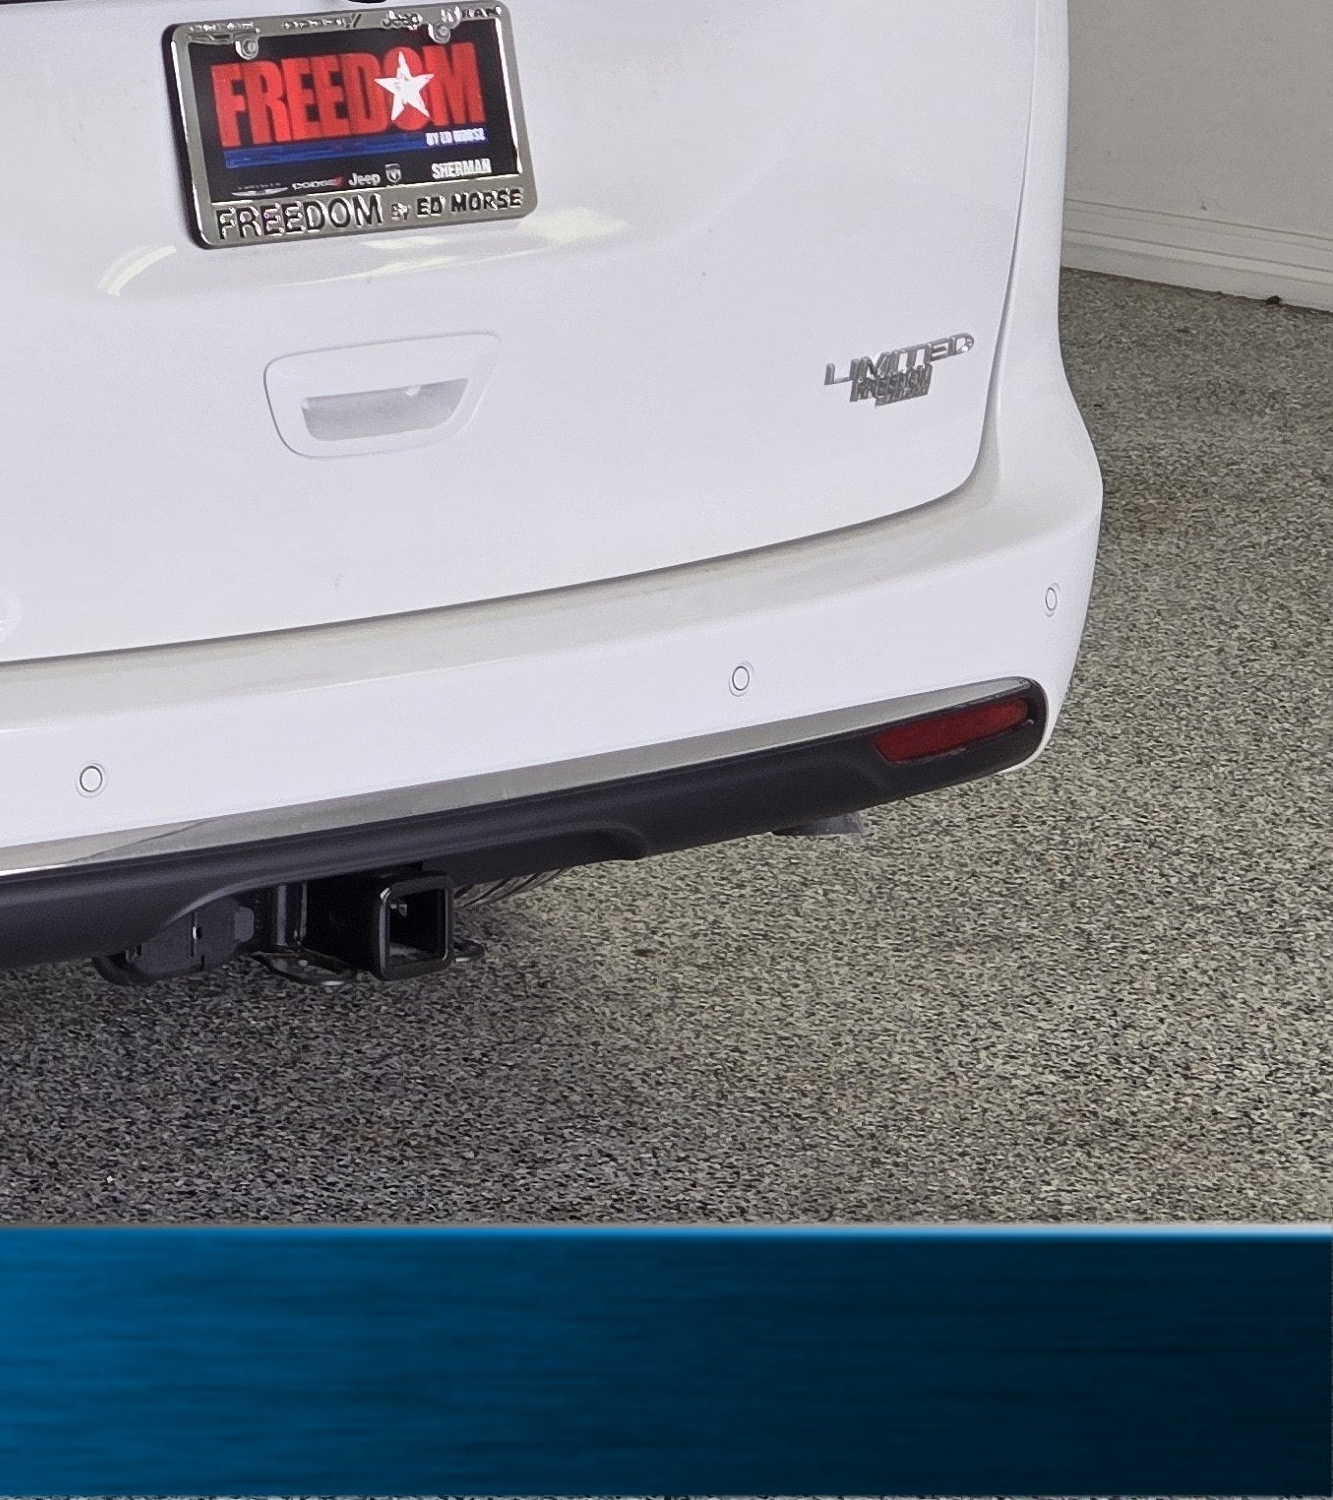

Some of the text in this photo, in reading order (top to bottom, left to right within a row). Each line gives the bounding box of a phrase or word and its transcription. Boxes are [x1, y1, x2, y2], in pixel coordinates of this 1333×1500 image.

[210, 41, 487, 148] FREEDOM
[348, 172, 381, 187] Jeep
[431, 158, 492, 179] SHERMAN
[215, 193, 384, 240] FREEDOM
[416, 196, 446, 218] ED
[450, 187, 524, 212] MORSE
[824, 333, 975, 386] LIMITED
